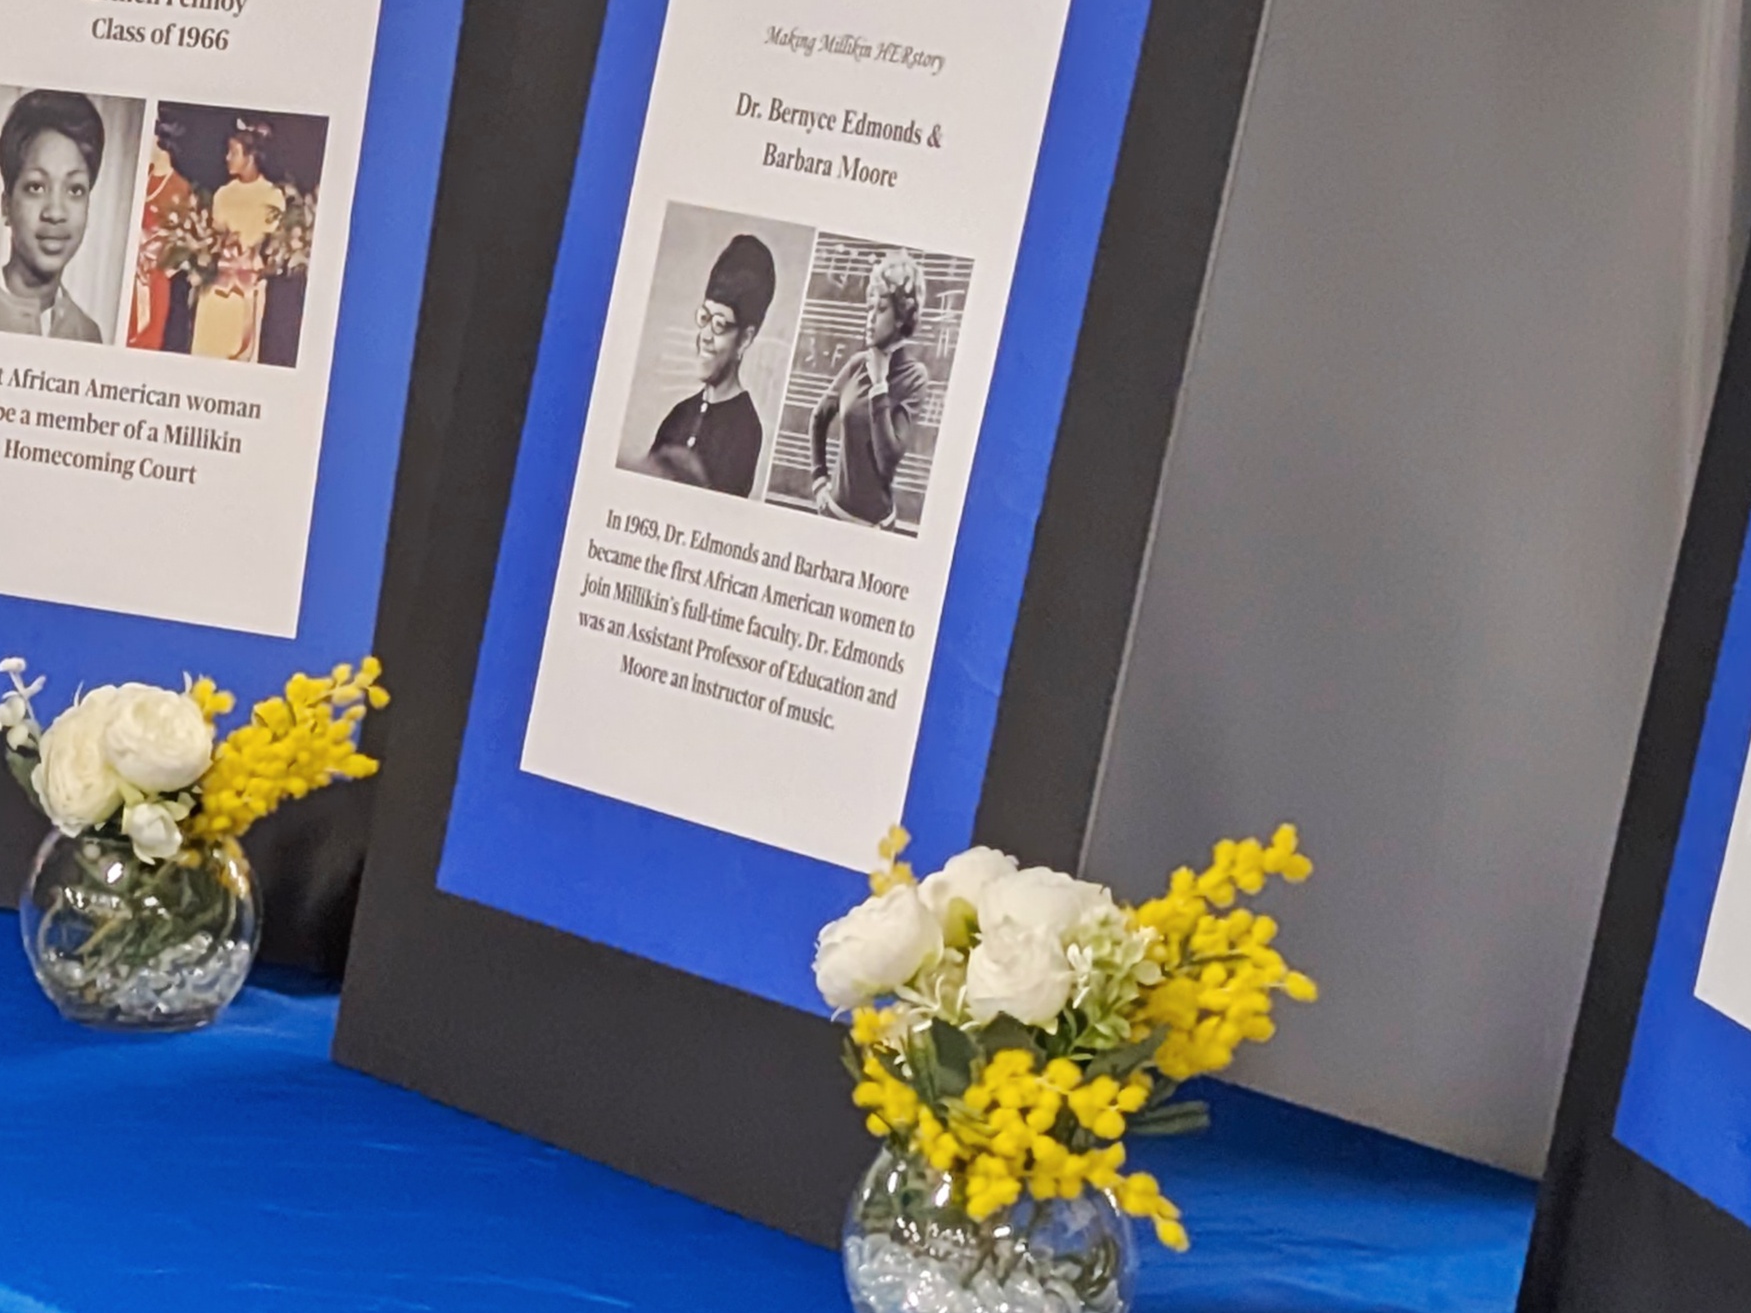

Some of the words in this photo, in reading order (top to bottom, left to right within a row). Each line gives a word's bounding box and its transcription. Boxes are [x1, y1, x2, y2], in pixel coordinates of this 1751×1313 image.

[91, 17, 146, 44] Class
[150, 23, 176, 46] of
[178, 26, 230, 51] 1966
[765, 25, 816, 56] Making
[817, 33, 872, 61] Millikin
[874, 42, 946, 76] HERstory
[736, 92, 761, 119] Dr.
[768, 97, 836, 134] Bernyce
[841, 109, 922, 145] Edmonds
[926, 124, 942, 149] &
[762, 142, 832, 176] Barbara
[837, 155, 898, 188] Moore
[8, 367, 80, 397] African
[85, 377, 181, 409] American
[186, 394, 262, 420] woman
[19, 409, 30, 426] a
[35, 412, 120, 439] member
[124, 420, 146, 441] of
[147, 426, 158, 443] a
[164, 425, 242, 454] Millikin
[4, 438, 136, 480] Homecoming
[139, 457, 196, 485] Court
[606, 509, 621, 530] In
[624, 514, 661, 541] 1969,
[664, 523, 686, 546] Dr.
[690, 530, 759, 563] Edmonds
[762, 551, 791, 574] and
[794, 555, 854, 587] Barbara
[858, 570, 909, 601] Moore
[587, 539, 642, 570] became
[645, 554, 668, 577] the
[670, 560, 701, 585] first
[704, 570, 758, 601] African
[761, 583, 835, 620] American
[839, 606, 895, 634] women
[900, 621, 915, 640] to
[580, 574, 610, 597] join
[613, 581, 679, 615] Millikin's
[682, 598, 745, 633] full-time
[746, 615, 802, 650] faculty.
[806, 631, 828, 655] Dr.
[832, 639, 904, 674] Edmonds
[578, 610, 605, 632] was
[607, 620, 624, 637] an
[627, 622, 695, 656] Assistant
[697, 638, 766, 675] Professor
[769, 658, 787, 680] of
[787, 664, 863, 701] Education
[867, 686, 897, 710] and
[620, 654, 668, 684] Moore
[670, 670, 689, 687] an
[692, 673, 765, 712] instructor
[768, 692, 786, 715] of
[787, 701, 835, 731] music.
